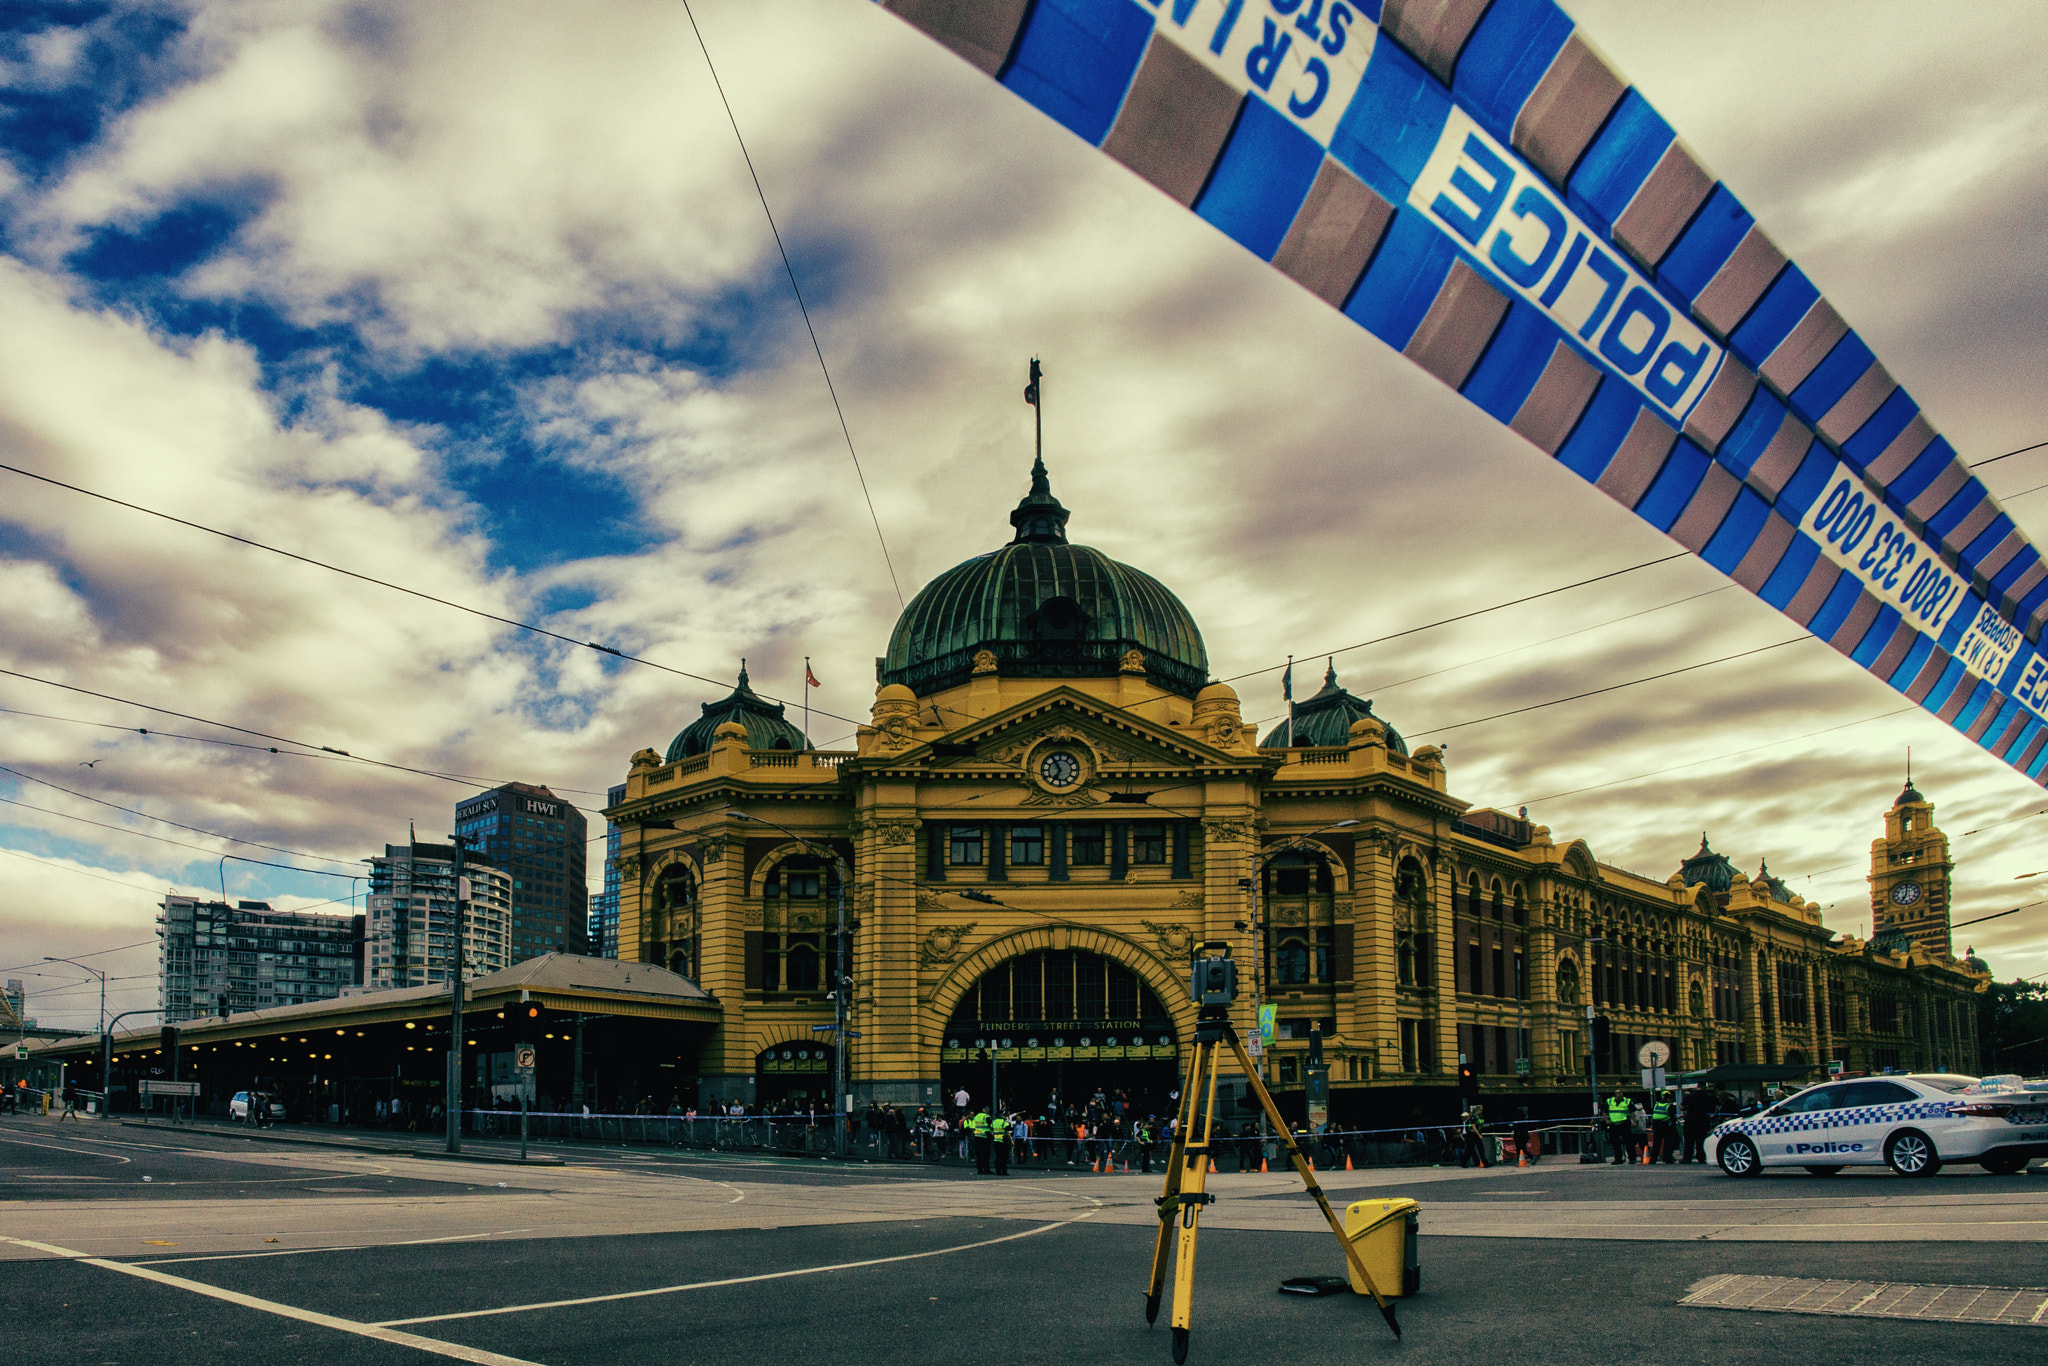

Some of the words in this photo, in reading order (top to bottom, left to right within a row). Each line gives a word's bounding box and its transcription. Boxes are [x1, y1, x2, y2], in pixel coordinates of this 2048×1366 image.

[1430, 131, 1711, 409] POLICE
[1813, 478, 1876, 555] 000
[1858, 521, 1917, 591] 333
[1899, 557, 1960, 629] 1800
[1976, 607, 2018, 654] STOPPERS
[1961, 633, 2004, 679] CRIME
[527, 800, 557, 816] HWT
[980, 1022, 1030, 1031] FLINDERS
[1043, 1022, 1082, 1031] STREET
[1094, 1021, 1140, 1030] STATION
[1796, 1141, 1864, 1154] Police
